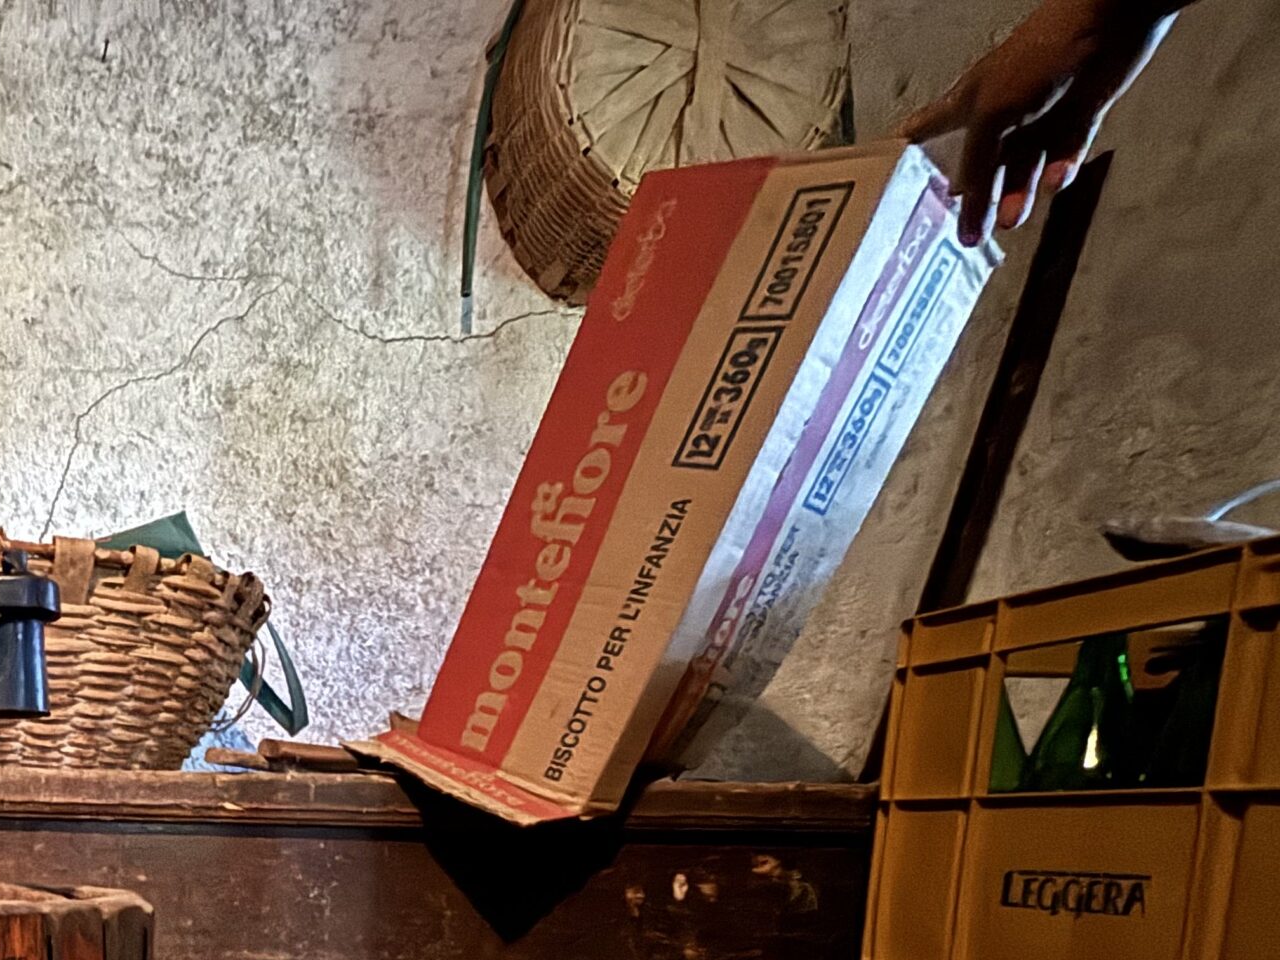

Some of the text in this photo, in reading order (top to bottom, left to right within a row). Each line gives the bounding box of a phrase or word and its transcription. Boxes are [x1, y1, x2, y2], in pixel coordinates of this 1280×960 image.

[758, 197, 833, 309] 70015801
[684, 432, 722, 460] 12
[712, 337, 770, 406] 360g
[813, 474, 835, 503] 12
[460, 369, 648, 753] montefiore
[543, 497, 693, 783] BISCOTTO PER L'INFANZIA
[1000, 870, 1148, 920] LEGGERA
